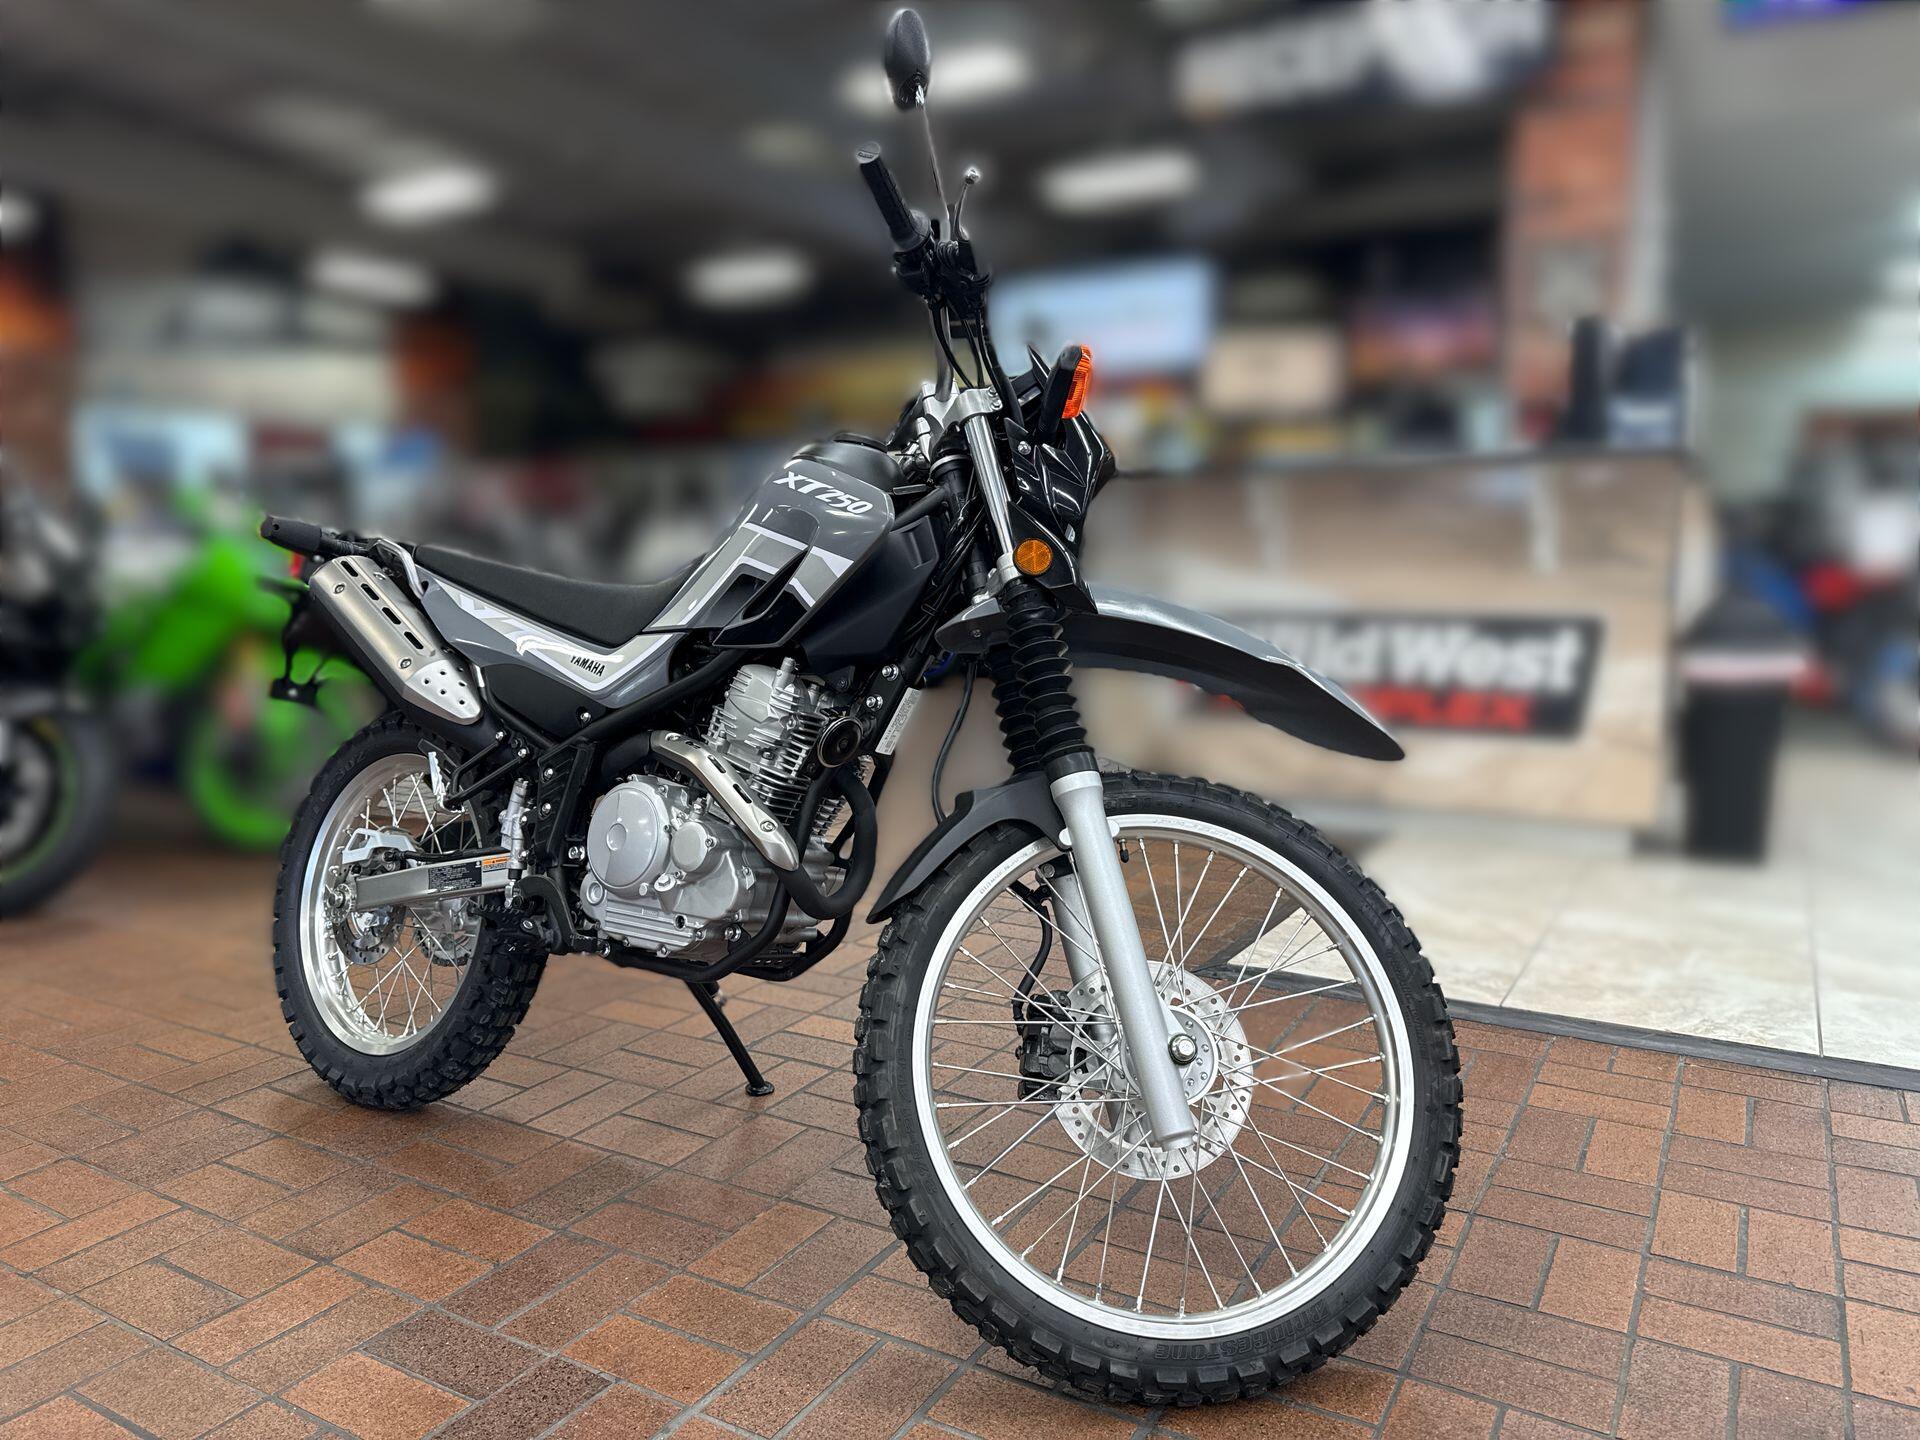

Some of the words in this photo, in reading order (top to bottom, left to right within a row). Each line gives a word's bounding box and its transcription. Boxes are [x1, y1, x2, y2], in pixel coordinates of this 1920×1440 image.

[773, 471, 873, 515] XT250
[570, 655, 606, 677] YAMAHA
[1389, 623, 1583, 691] West
[1155, 1297, 1330, 1361] BRIDGESTONE
